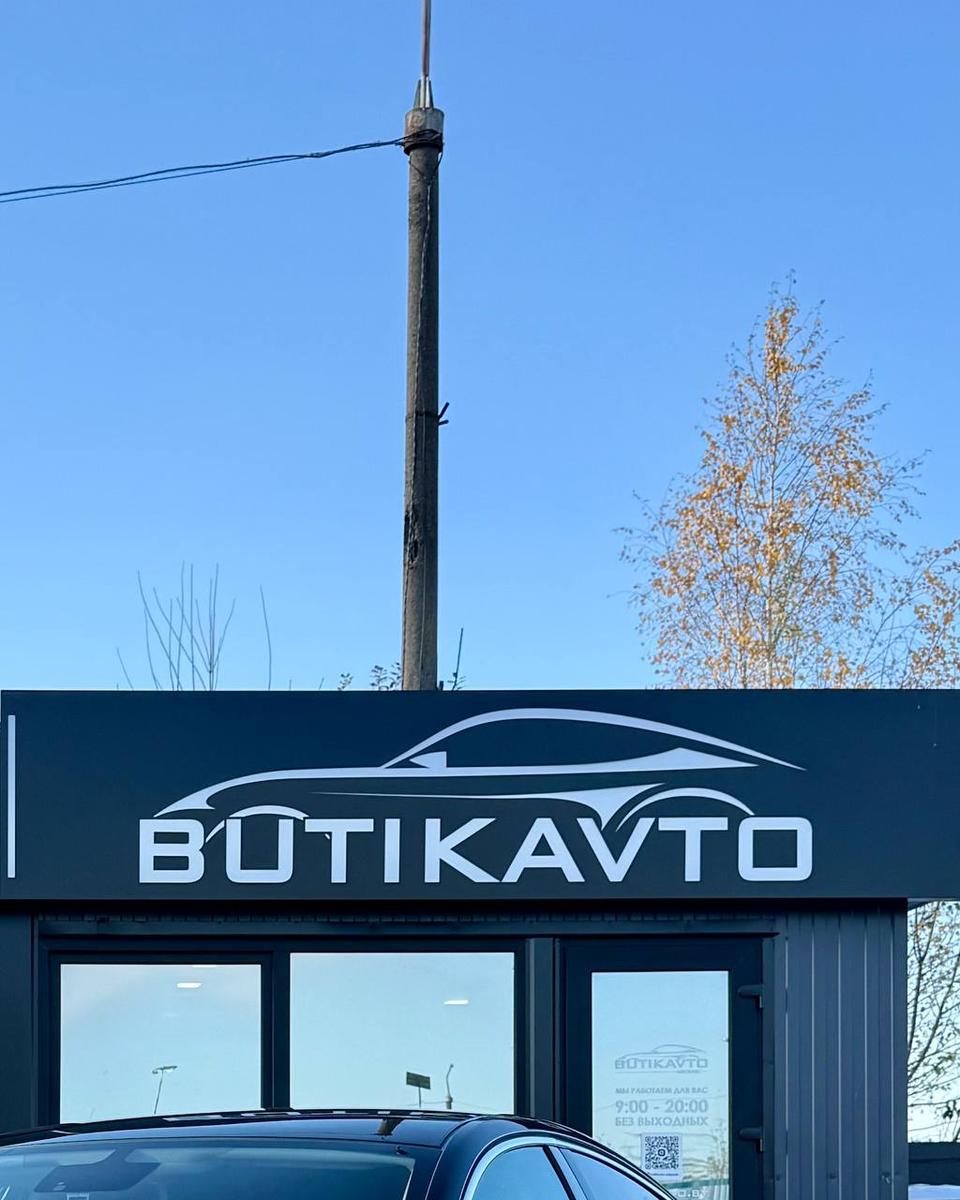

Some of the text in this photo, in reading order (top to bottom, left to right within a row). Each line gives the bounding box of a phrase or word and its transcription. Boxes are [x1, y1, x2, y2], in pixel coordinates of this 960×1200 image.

[139, 816, 813, 884] BUTIKAVTO
[615, 1058, 708, 1070] BUTIKAVTO
[616, 1099, 648, 1113] 9:00
[665, 1099, 709, 1113] 20:00
[616, 1117, 709, 1127] БЕЗ ВЫХОДНЫХ
